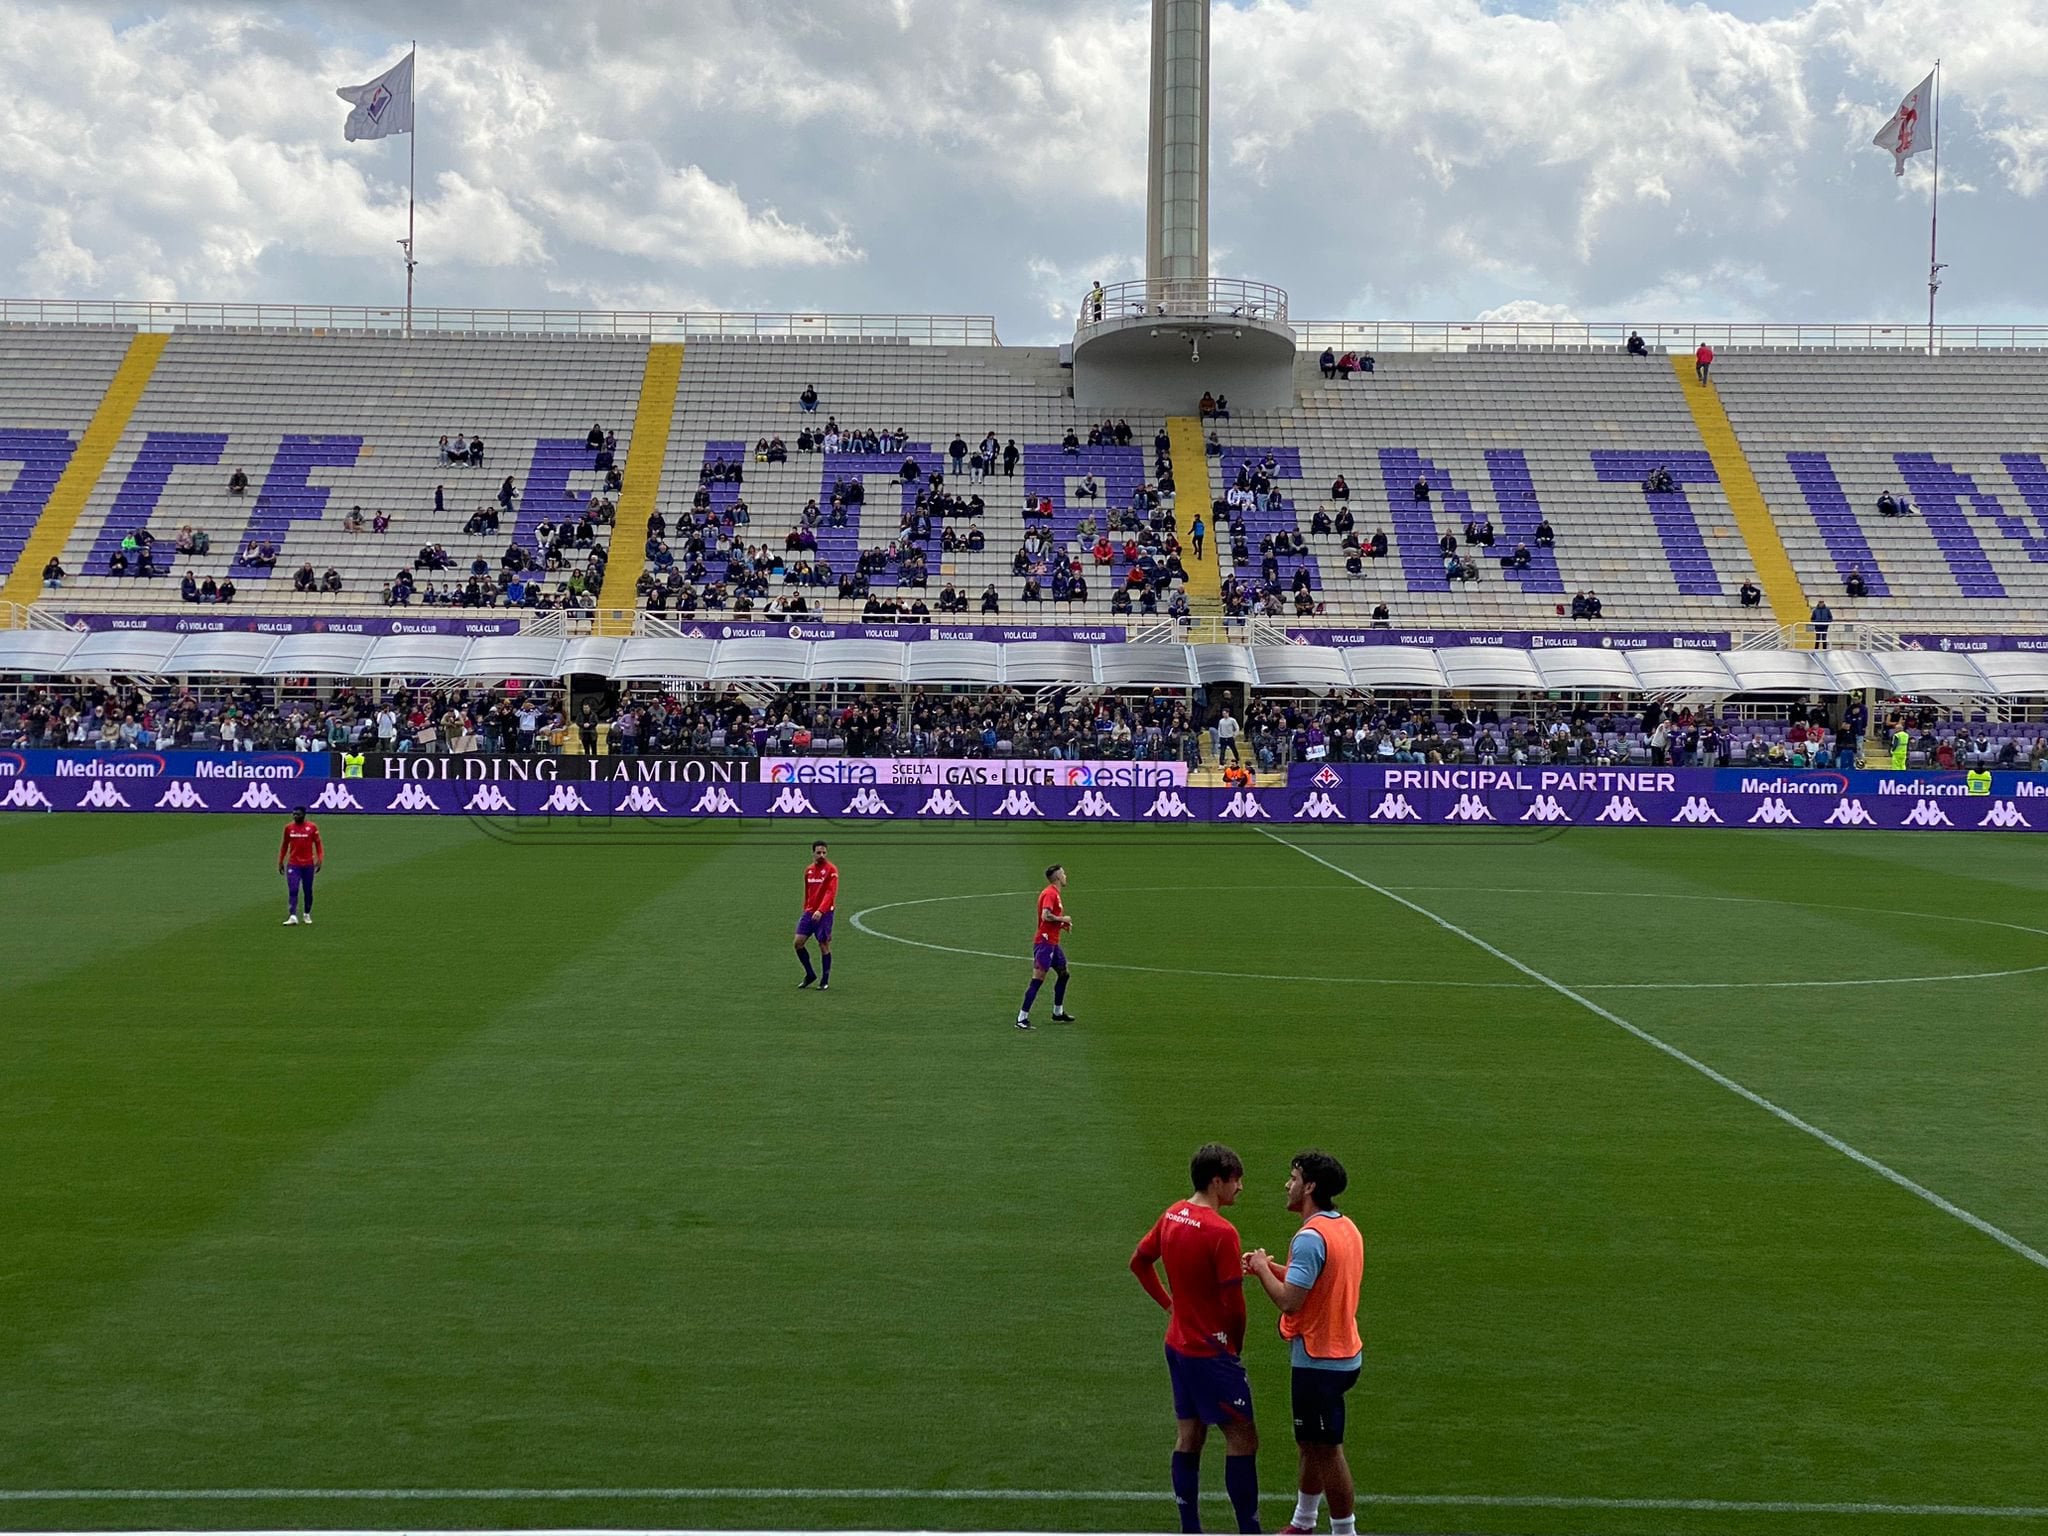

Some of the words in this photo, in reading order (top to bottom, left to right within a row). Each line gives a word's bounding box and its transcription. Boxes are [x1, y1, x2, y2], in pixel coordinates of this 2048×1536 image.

[112, 620, 130, 629] VIOLA
[131, 620, 147, 629] CLUB
[189, 622, 207, 631] VIOLA
[208, 622, 224, 631] CLUB
[257, 623, 275, 632] VIOLA
[276, 623, 292, 632] CLUB
[328, 624, 346, 632] VIOLA
[347, 624, 362, 632] CLUB
[403, 625, 421, 633] VIOLA
[421, 625, 436, 633] CLUB
[466, 624, 484, 633] VIOLA
[484, 624, 499, 633] CLUB
[732, 629, 750, 637] VIOLA
[750, 629, 765, 637] CLUB
[802, 630, 819, 638] VIOLA
[820, 630, 835, 638] CLUB
[865, 629, 883, 638] VIOLA
[884, 629, 899, 638] CLUB
[940, 631, 958, 640] VIOLA
[958, 631, 973, 640] CLUB
[1003, 631, 1021, 640] VIOLA
[1022, 631, 1037, 640] CLUB
[1073, 632, 1091, 640] VIOLA
[1091, 632, 1106, 640] CLUB
[1331, 635, 1349, 643] VIOLA
[1350, 635, 1365, 643] CLUB
[1400, 636, 1418, 644] VIOLA
[1419, 636, 1434, 644] CLUB
[1470, 636, 1487, 644] VIOLA
[1488, 636, 1503, 644] CLUB
[1544, 638, 1561, 647] VIOLA
[1562, 638, 1577, 647] CLUB
[1613, 638, 1631, 647] VIOLA
[1632, 638, 1647, 647] CLUB
[1683, 639, 1701, 647] VIOLA
[1701, 639, 1717, 647] CLUB
[1953, 642, 1971, 650] VIOLA
[1971, 642, 1988, 650] CLUB
[2017, 641, 2035, 649] VIOLA
[56, 759, 154, 777] Mediacom
[195, 760, 293, 778] Mediacom
[383, 757, 558, 781] HOLDING
[588, 759, 749, 783] LAMIONI
[797, 760, 877, 784] estra
[892, 764, 932, 775] SCELTA
[946, 767, 987, 785] GAS
[1094, 764, 1174, 786] estra
[1384, 769, 1532, 790] PRINCIPAL
[1542, 772, 1675, 792] PARTNER
[1741, 778, 1838, 794] Mediacom
